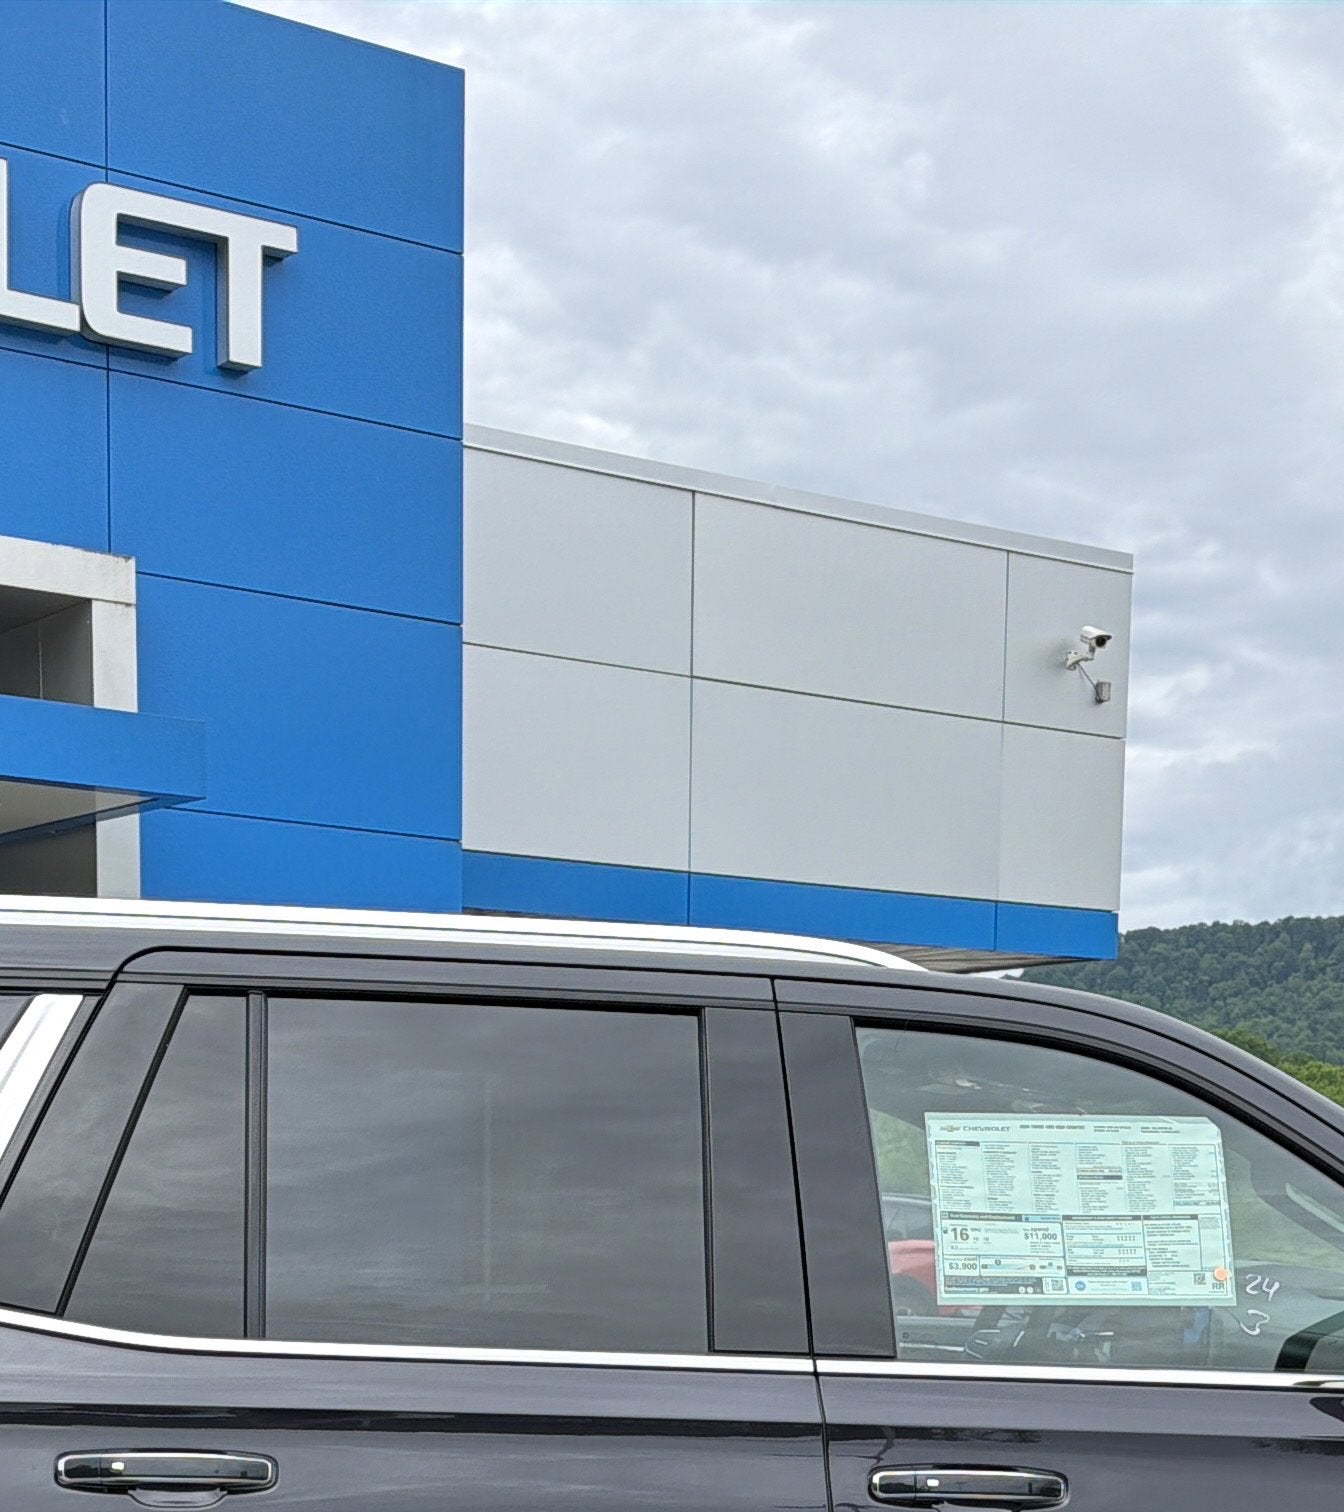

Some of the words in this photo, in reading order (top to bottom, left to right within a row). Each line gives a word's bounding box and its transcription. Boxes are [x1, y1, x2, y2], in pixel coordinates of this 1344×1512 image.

[962, 1125, 1011, 1133] CHEVROLET
[950, 1227, 970, 1241] 16
[1023, 1232, 1058, 1241] $11,000
[1245, 1273, 1280, 1302] 24
